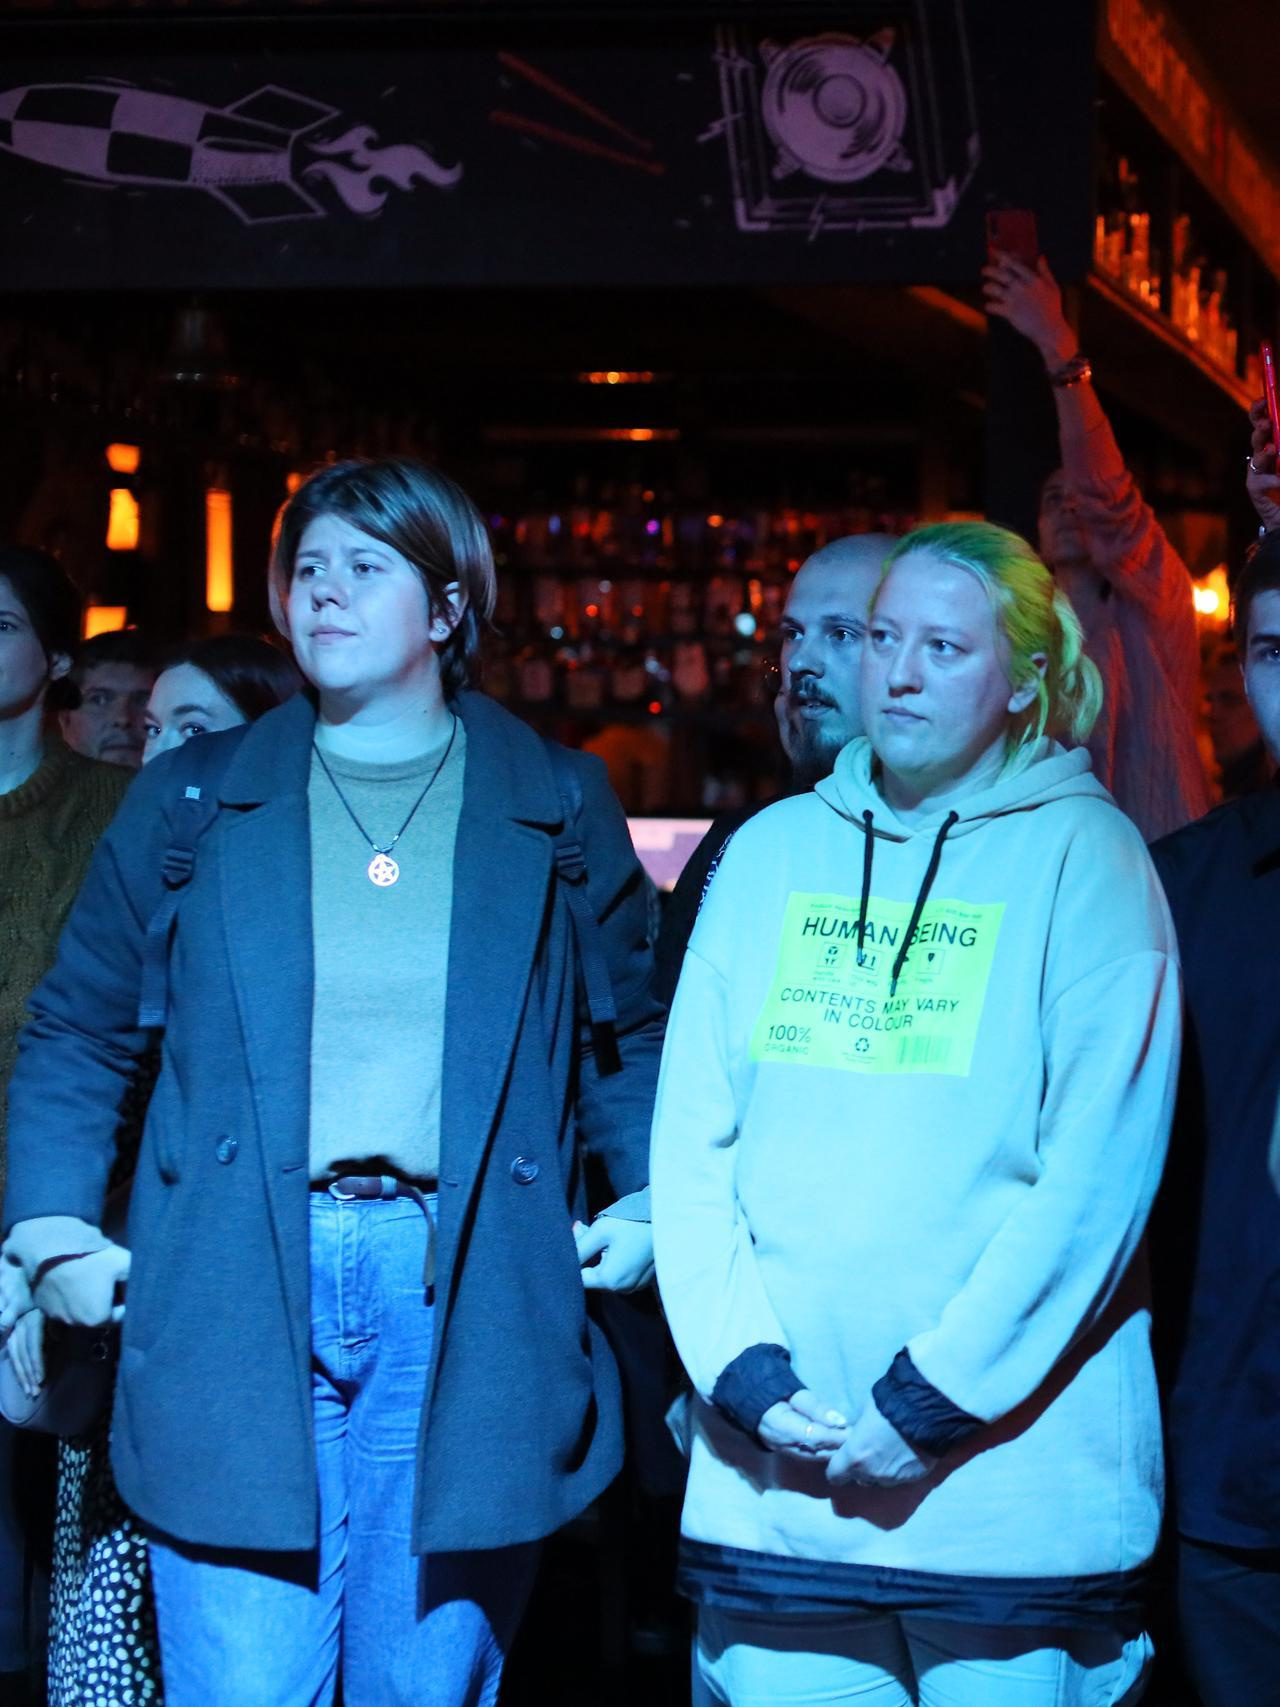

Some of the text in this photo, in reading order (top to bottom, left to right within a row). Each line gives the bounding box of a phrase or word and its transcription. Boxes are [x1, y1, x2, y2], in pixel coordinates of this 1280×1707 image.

[802, 917, 977, 947] HUMAN BEING
[780, 988, 959, 1015] CONTENTS MAY VARY
[823, 1009, 913, 1031] IN COLOUR
[768, 1025, 811, 1043] 100%
